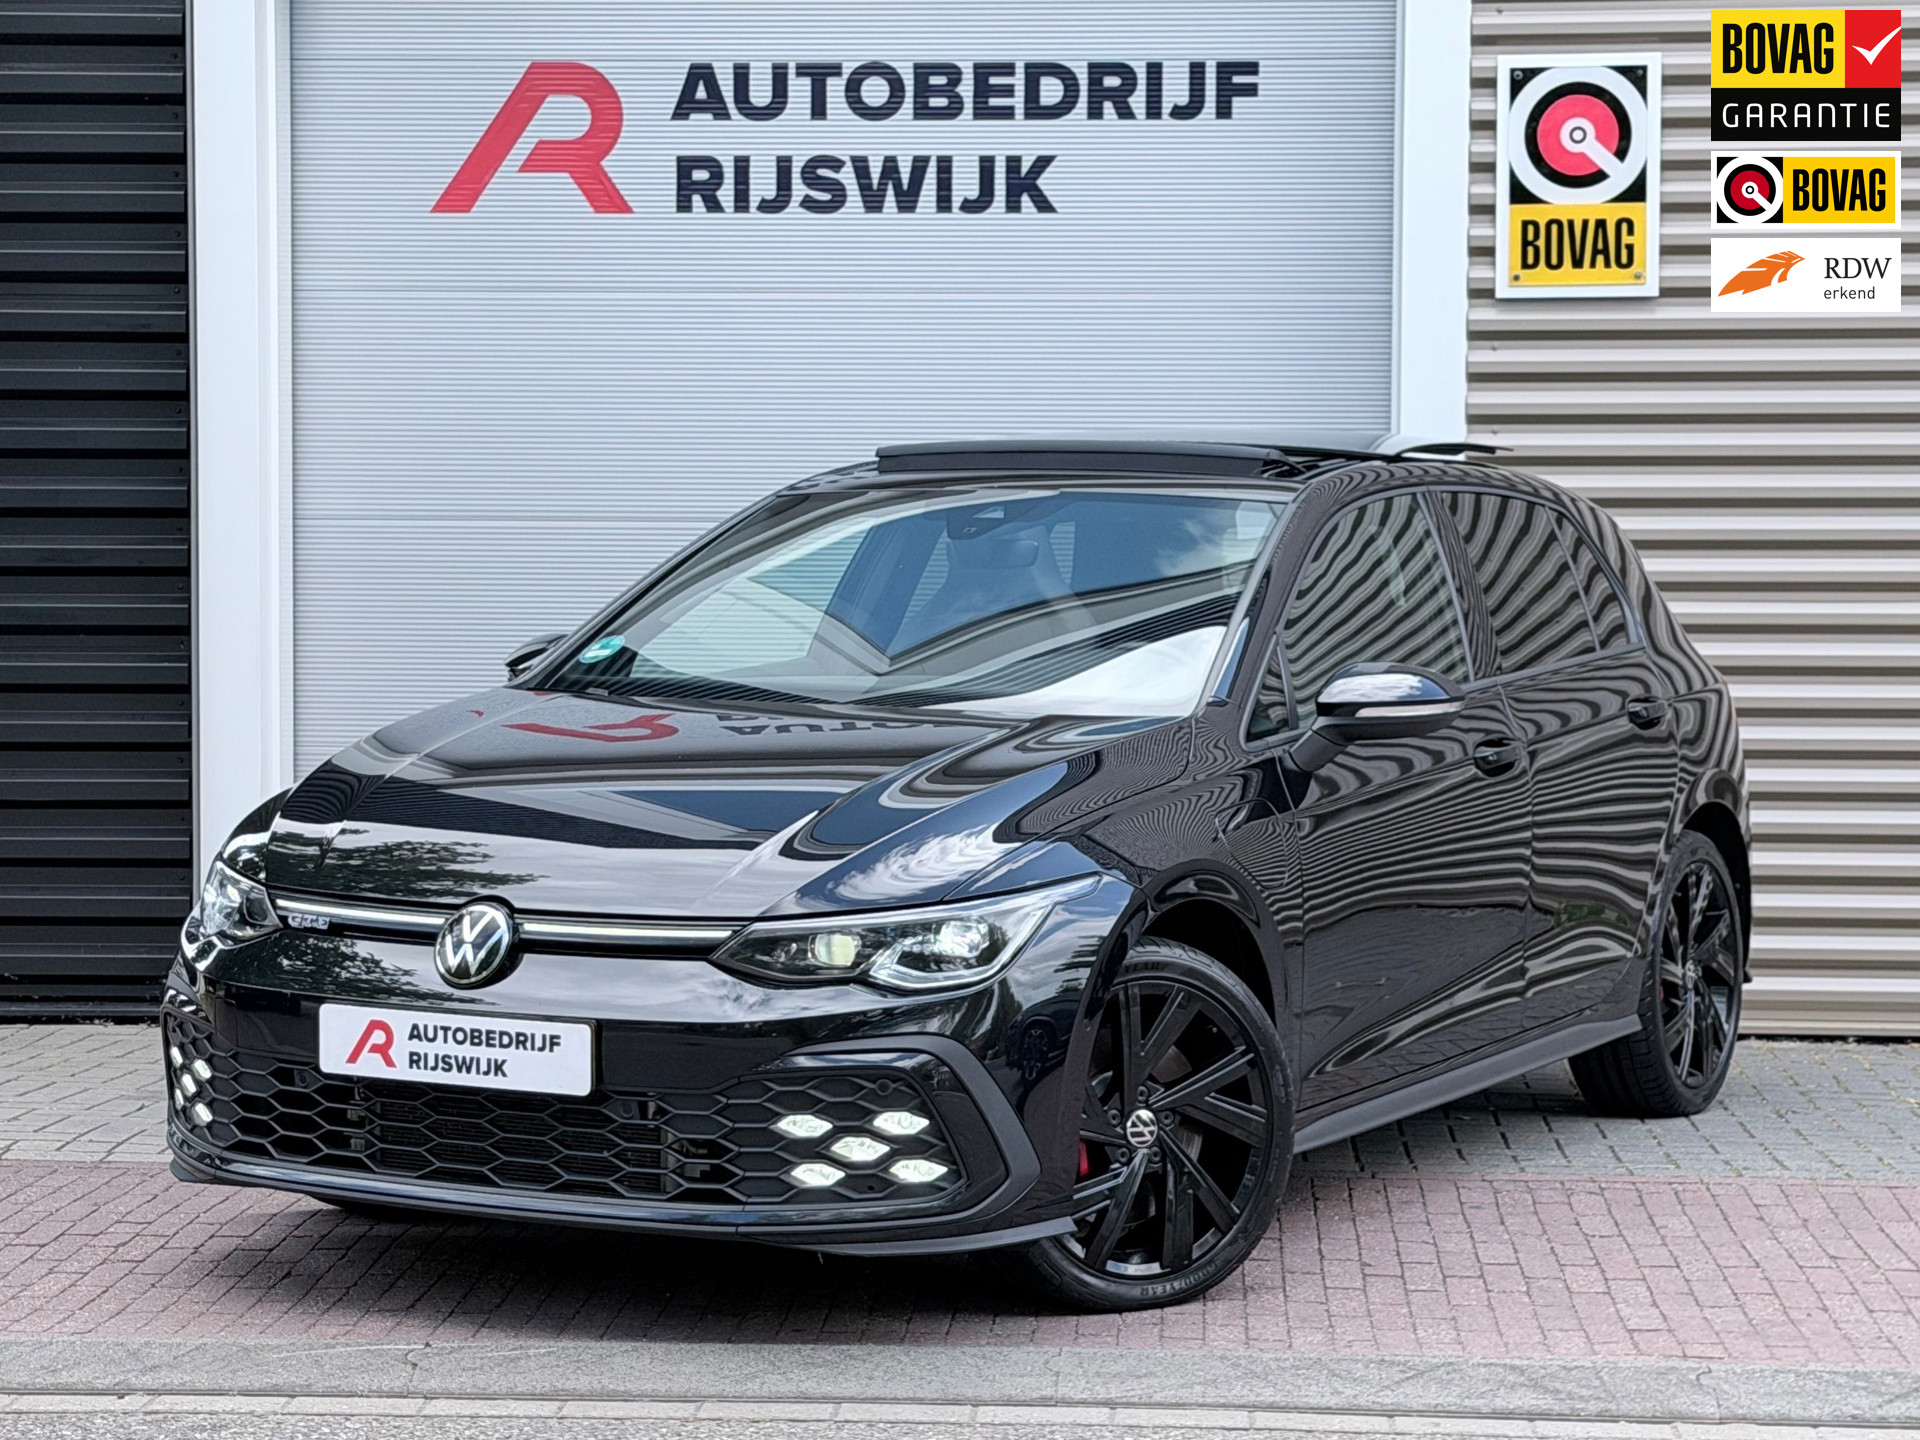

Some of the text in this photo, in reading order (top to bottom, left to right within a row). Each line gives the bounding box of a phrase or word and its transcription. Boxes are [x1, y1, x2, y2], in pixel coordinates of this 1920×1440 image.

[671, 61, 1260, 121] AUTOBEDRIJF
[675, 154, 1058, 214] RIJSWIJK
[1520, 217, 1635, 271] BOVAG
[407, 1022, 562, 1053] AUTOBEDRIJF
[408, 1051, 509, 1078] RIJSWIJK
